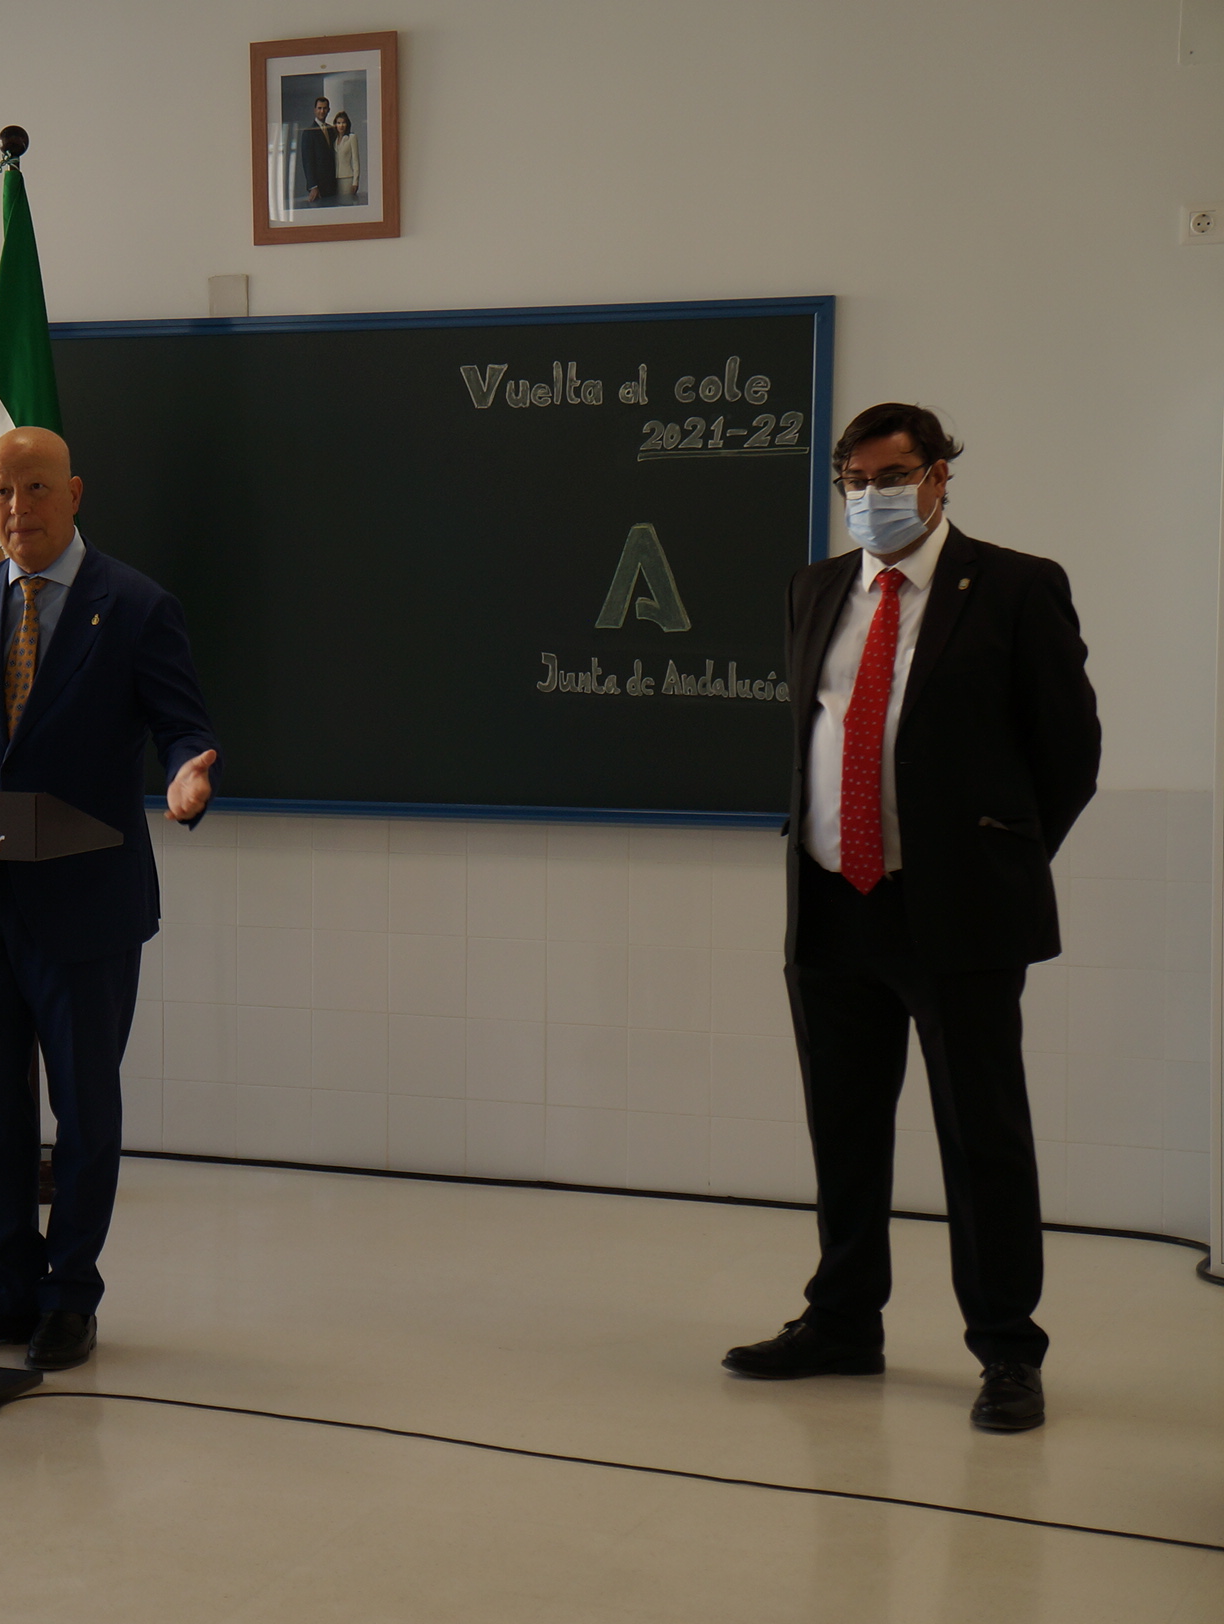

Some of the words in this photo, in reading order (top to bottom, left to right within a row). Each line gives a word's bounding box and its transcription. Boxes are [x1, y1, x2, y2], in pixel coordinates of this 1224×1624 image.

[459, 360, 603, 409] Vuelta
[618, 363, 649, 405] al
[674, 355, 772, 405] cole
[639, 411, 804, 450] 2021-22
[536, 651, 622, 695] Junta
[626, 658, 656, 696] de
[661, 659, 792, 702] Andalucía
